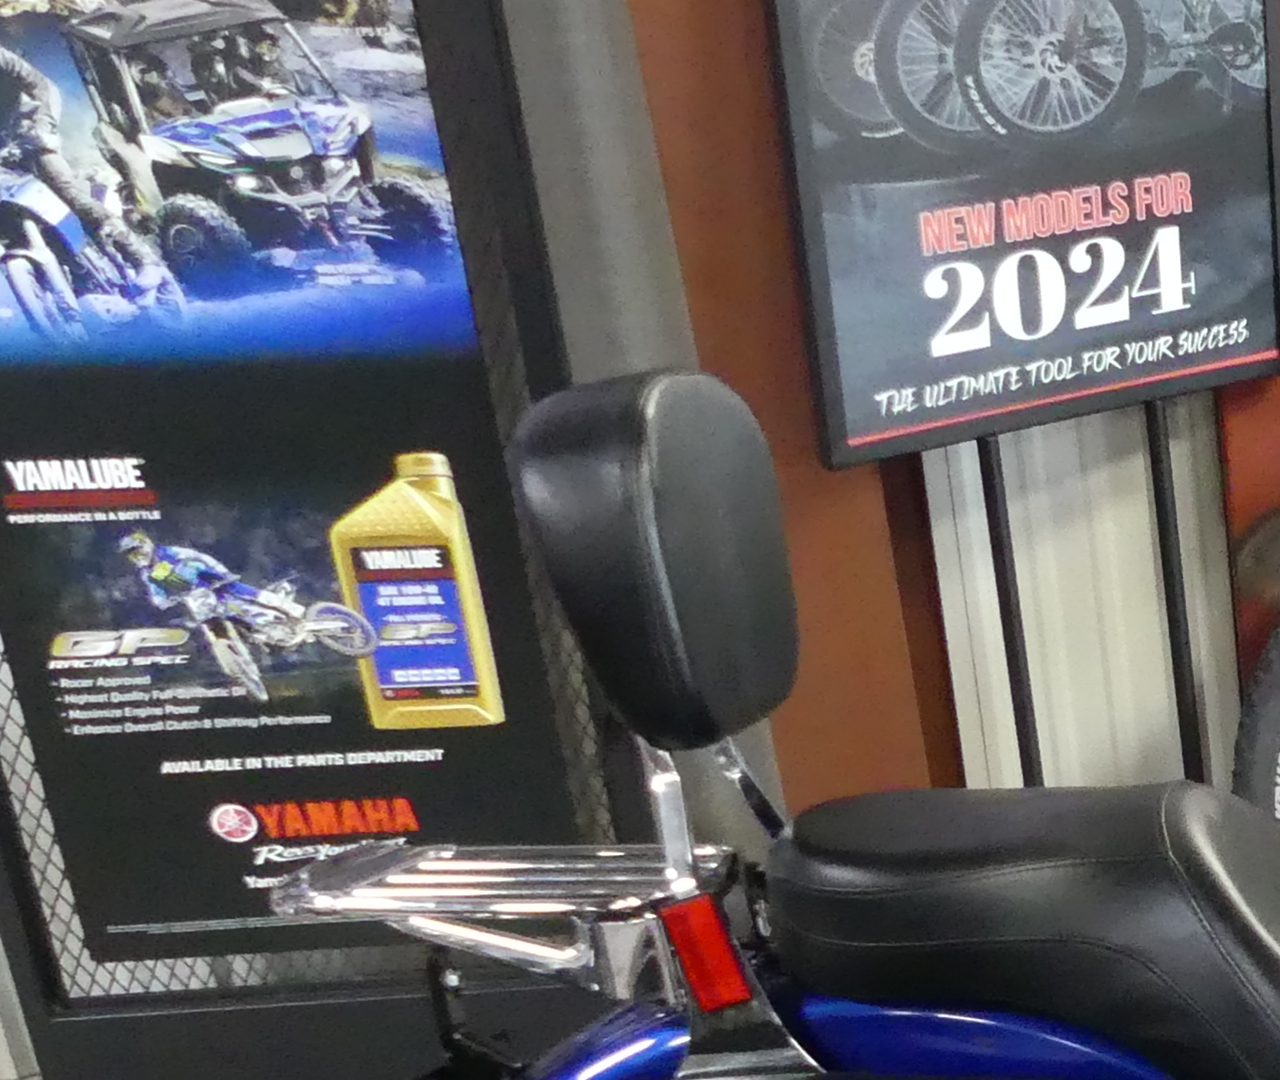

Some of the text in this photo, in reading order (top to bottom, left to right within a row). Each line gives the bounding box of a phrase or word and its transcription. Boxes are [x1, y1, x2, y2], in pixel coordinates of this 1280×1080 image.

[920, 172, 1193, 256] NEW MODELS FOR
[924, 226, 1196, 357] 2024
[874, 390, 916, 416] THE
[923, 367, 1022, 408] ULTIMATE
[1027, 358, 1081, 385] TOOL
[1082, 348, 1122, 376] FOR
[1124, 337, 1175, 366] YOUR
[4, 457, 146, 491] YAMALUBE
[8, 512, 92, 524] PERFORMANCE
[94, 512, 107, 521] IN
[119, 510, 161, 521] BOTTLE
[50, 628, 189, 657] GP
[48, 655, 190, 669] RACING SPEC
[161, 749, 445, 774] AVAILABLE IN THE PARTS DEPARTMENT
[254, 796, 420, 839] YAMAHA
